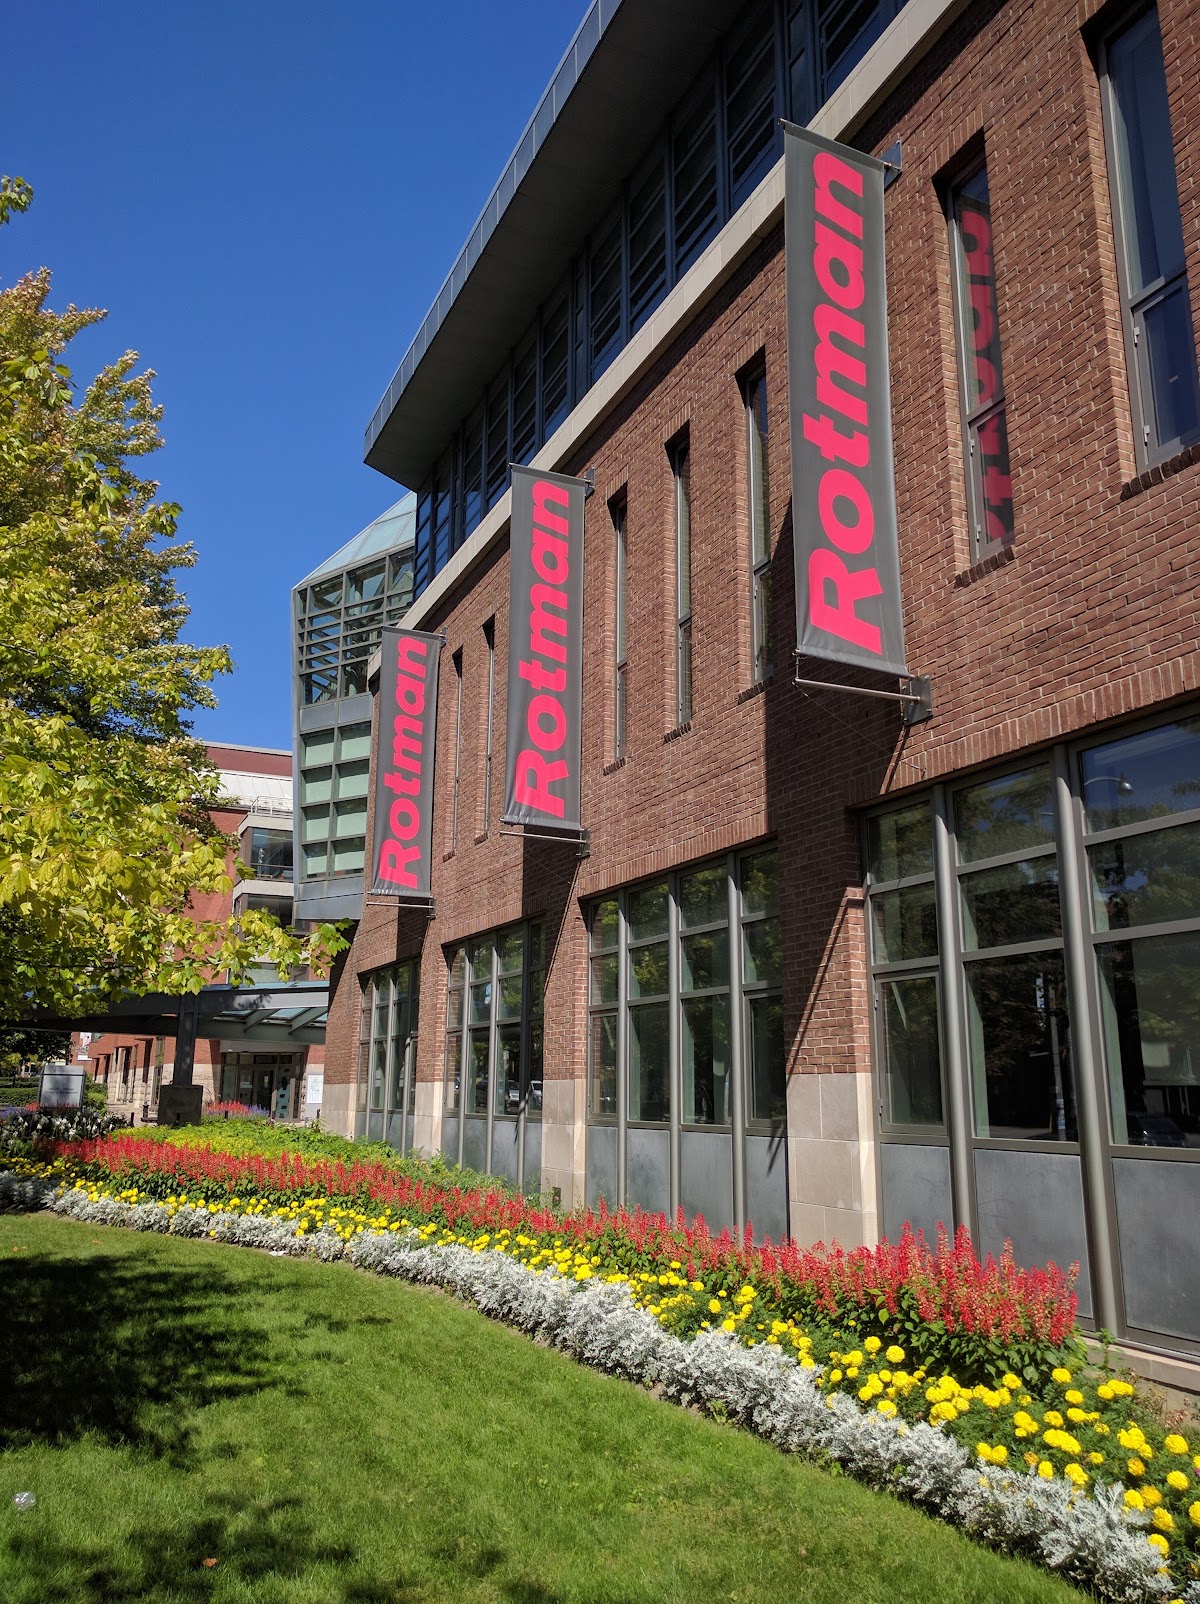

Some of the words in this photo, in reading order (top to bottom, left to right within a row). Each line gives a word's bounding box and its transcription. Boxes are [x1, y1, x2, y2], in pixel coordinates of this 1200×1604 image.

[803, 152, 883, 655] Rotman
[379, 637, 427, 889] Rotman
[514, 481, 570, 818] Rotman
